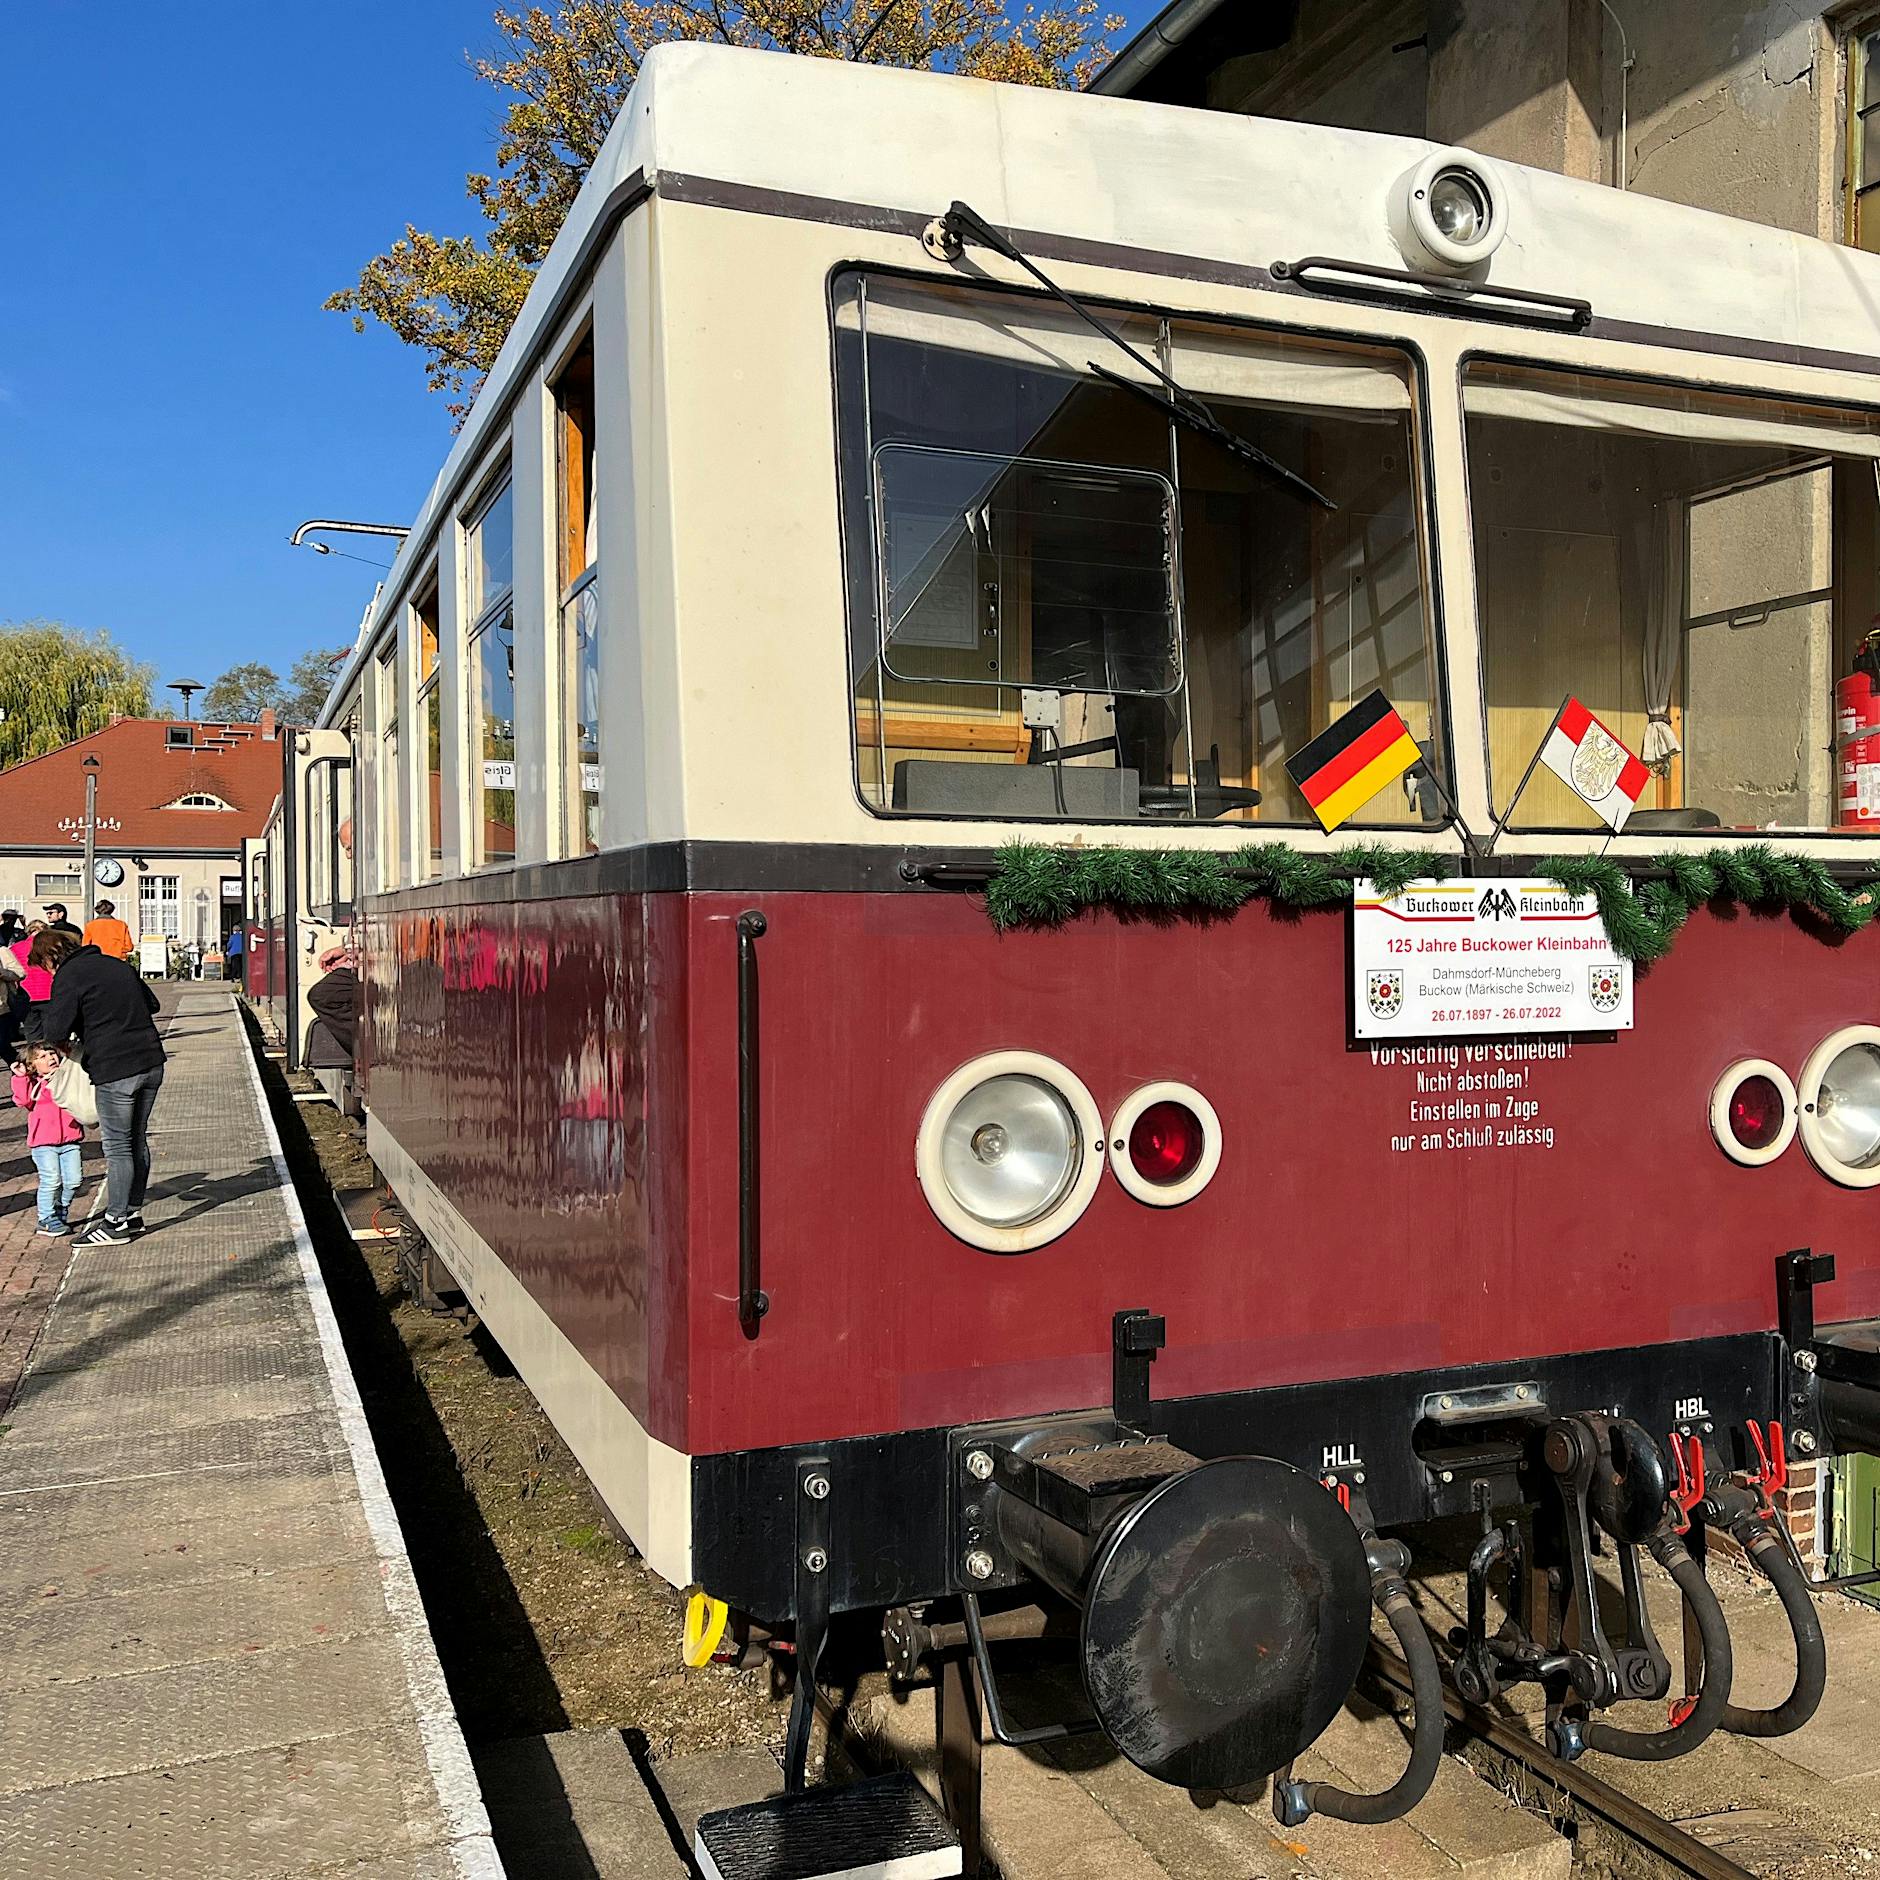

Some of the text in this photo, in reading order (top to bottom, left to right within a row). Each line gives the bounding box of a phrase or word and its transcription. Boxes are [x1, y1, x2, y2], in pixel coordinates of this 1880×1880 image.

[1406, 896, 1585, 914] Buckower Kleinbahn
[1387, 936, 1607, 953] 125 Jahre Buckower Kleinbahn
[1433, 965, 1561, 980] Dahmsdorf-Müncheberg
[1419, 981, 1574, 997] Buckow (Märkische Schweiz)
[1431, 1009, 1492, 1022] 26.07.1897
[1502, 1006, 1562, 1019] 26.07.2022
[1370, 1035, 1573, 1069] Vorsichtig verschieben!
[1416, 1066, 1530, 1093] Nicht abstoßen!
[1410, 1096, 1539, 1122] Einstellen im Zuge
[1391, 1124, 1555, 1151] nur am Schluß zulässig
[1675, 1397, 1709, 1419] HBL
[1322, 1443, 1362, 1467] HLL
